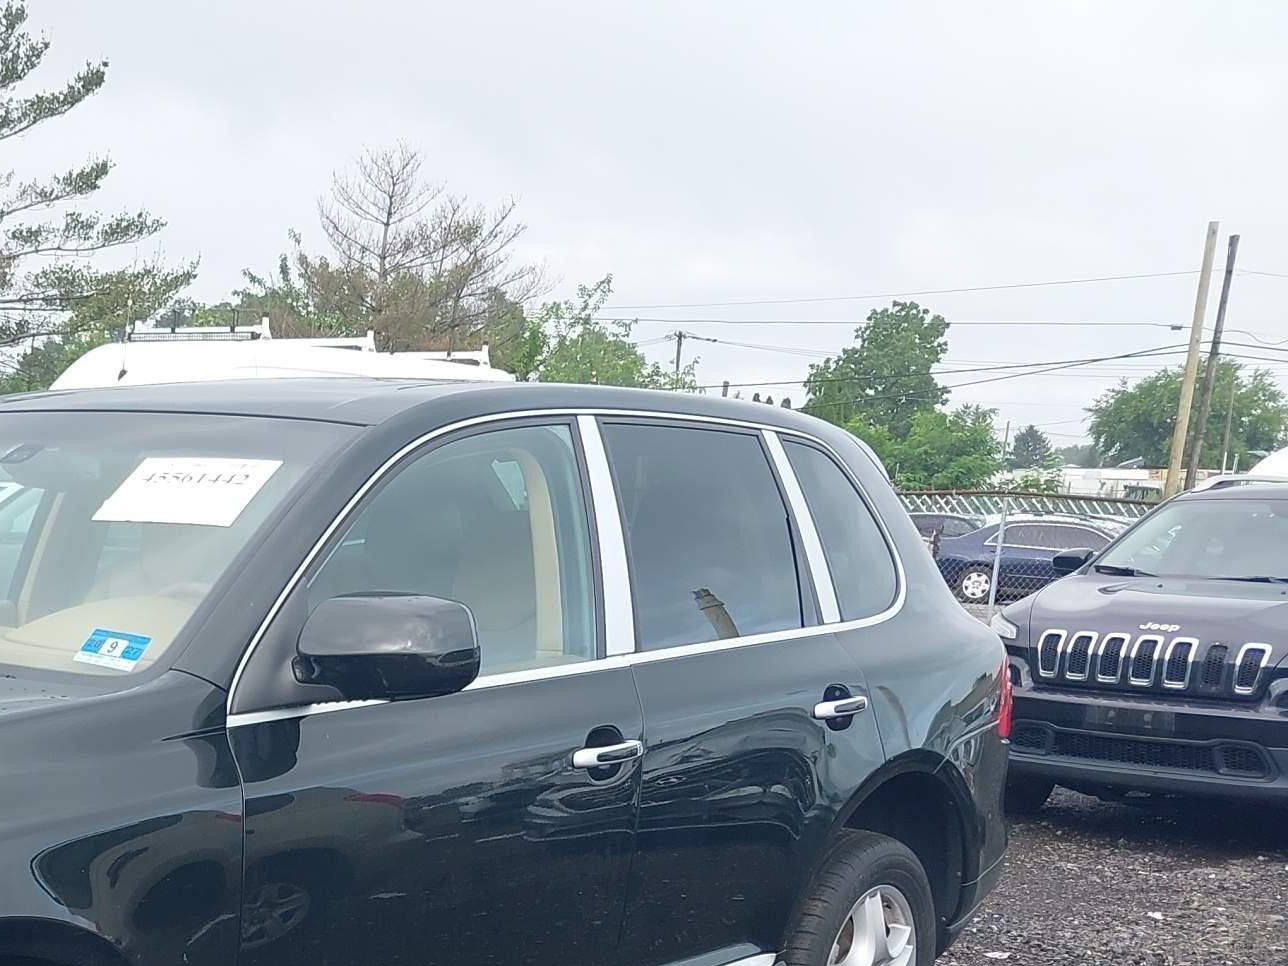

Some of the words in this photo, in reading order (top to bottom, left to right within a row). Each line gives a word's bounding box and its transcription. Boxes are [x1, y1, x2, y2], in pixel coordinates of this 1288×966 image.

[143, 472, 250, 485] 45561442
[1139, 621, 1180, 632] Jeep
[107, 641, 119, 653] 9
